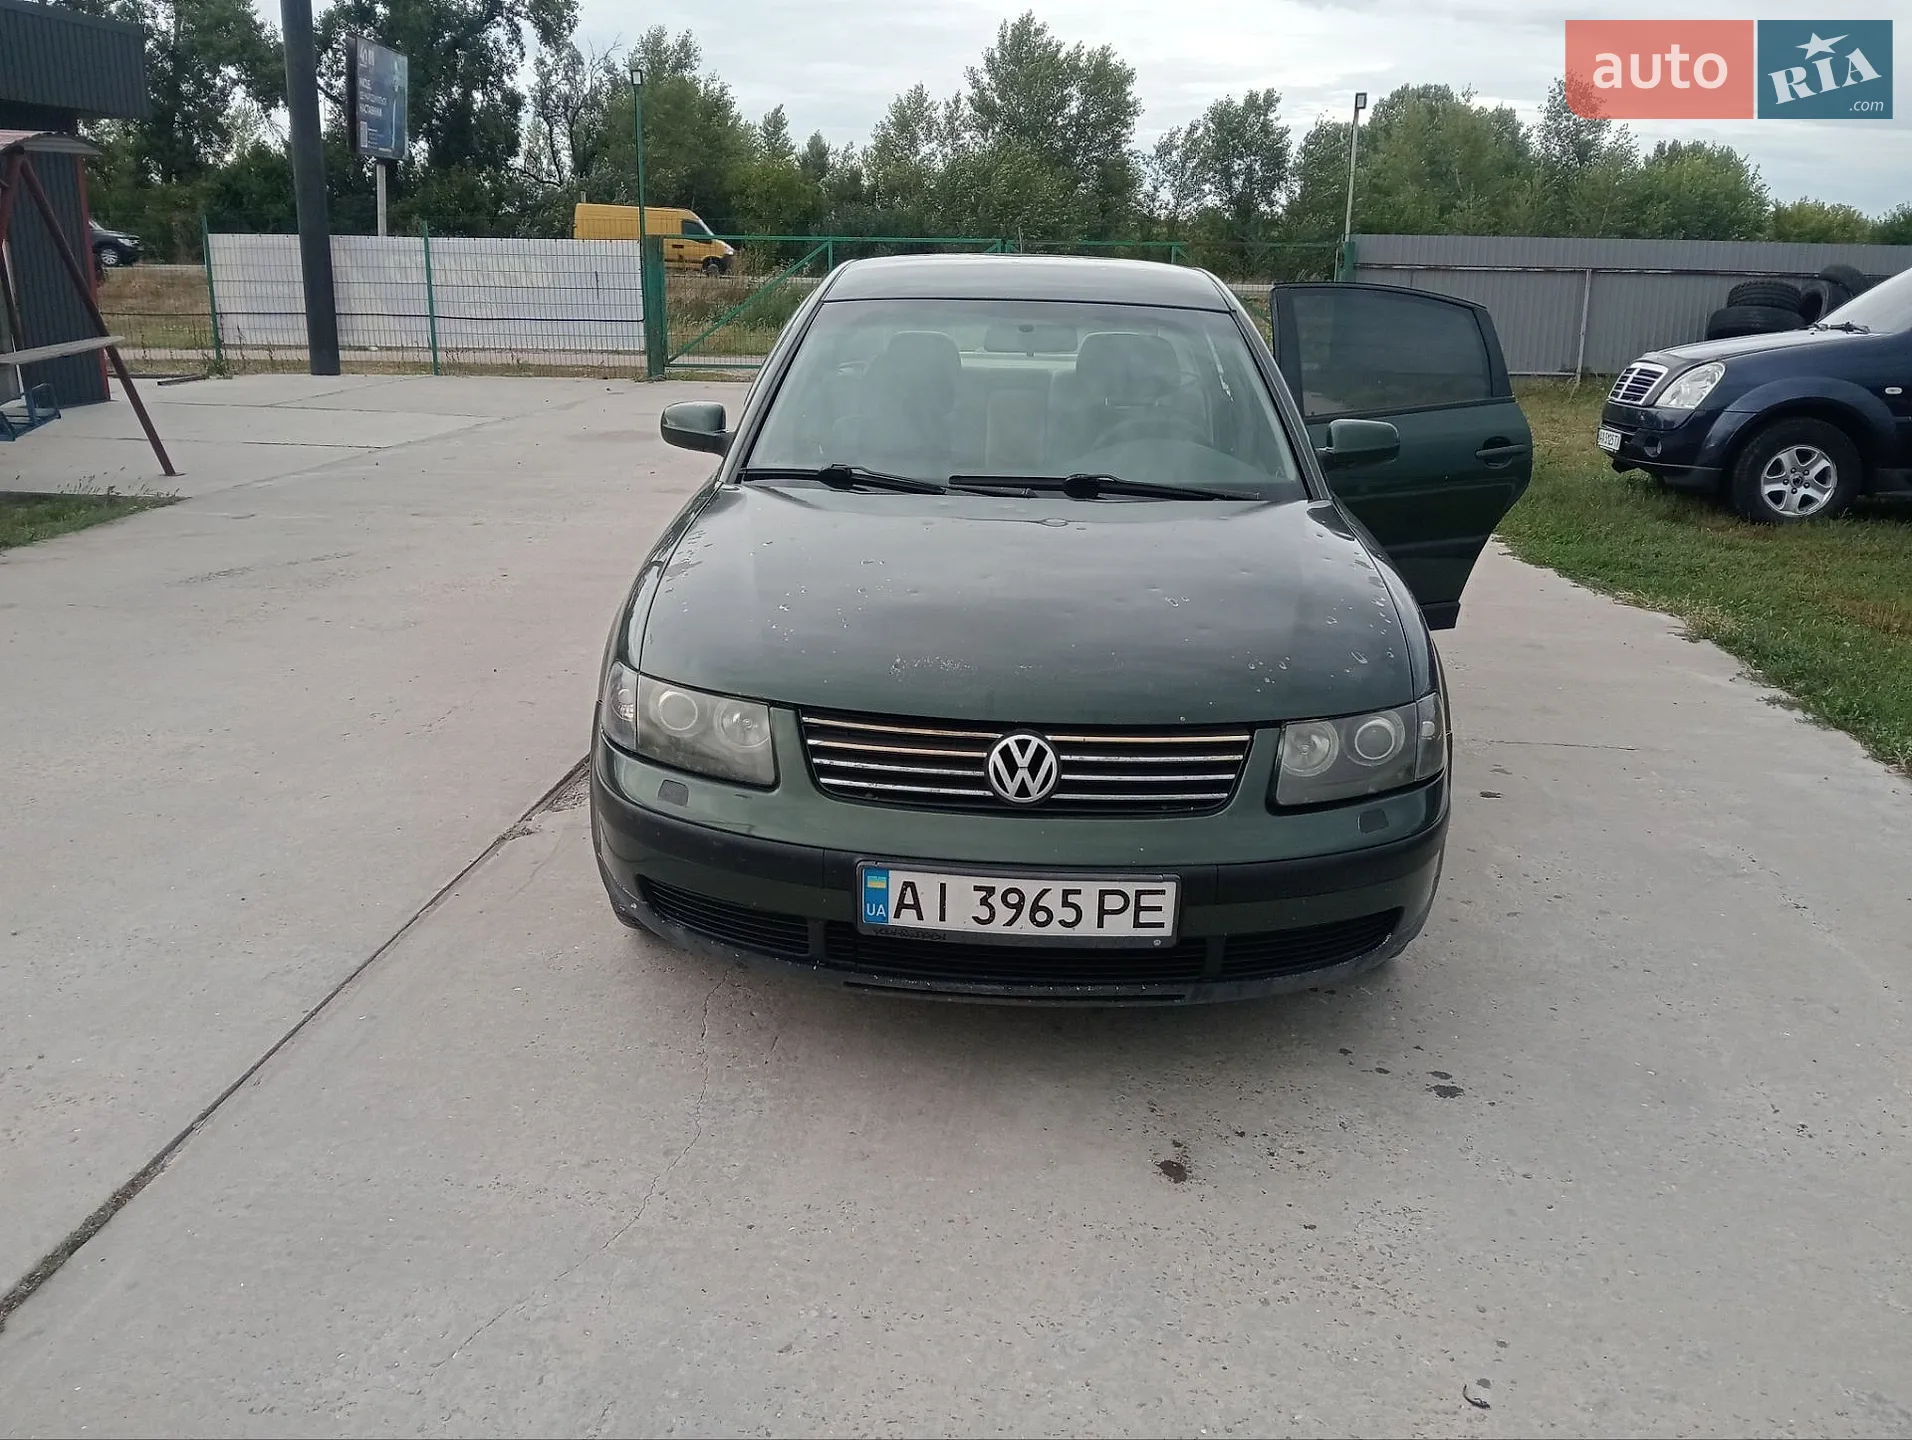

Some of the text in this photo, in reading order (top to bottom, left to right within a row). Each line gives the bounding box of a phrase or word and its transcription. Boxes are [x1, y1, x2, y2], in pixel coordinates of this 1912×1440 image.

[866, 903, 886, 917] UA
[893, 880, 1167, 929] AI 3965 PE
